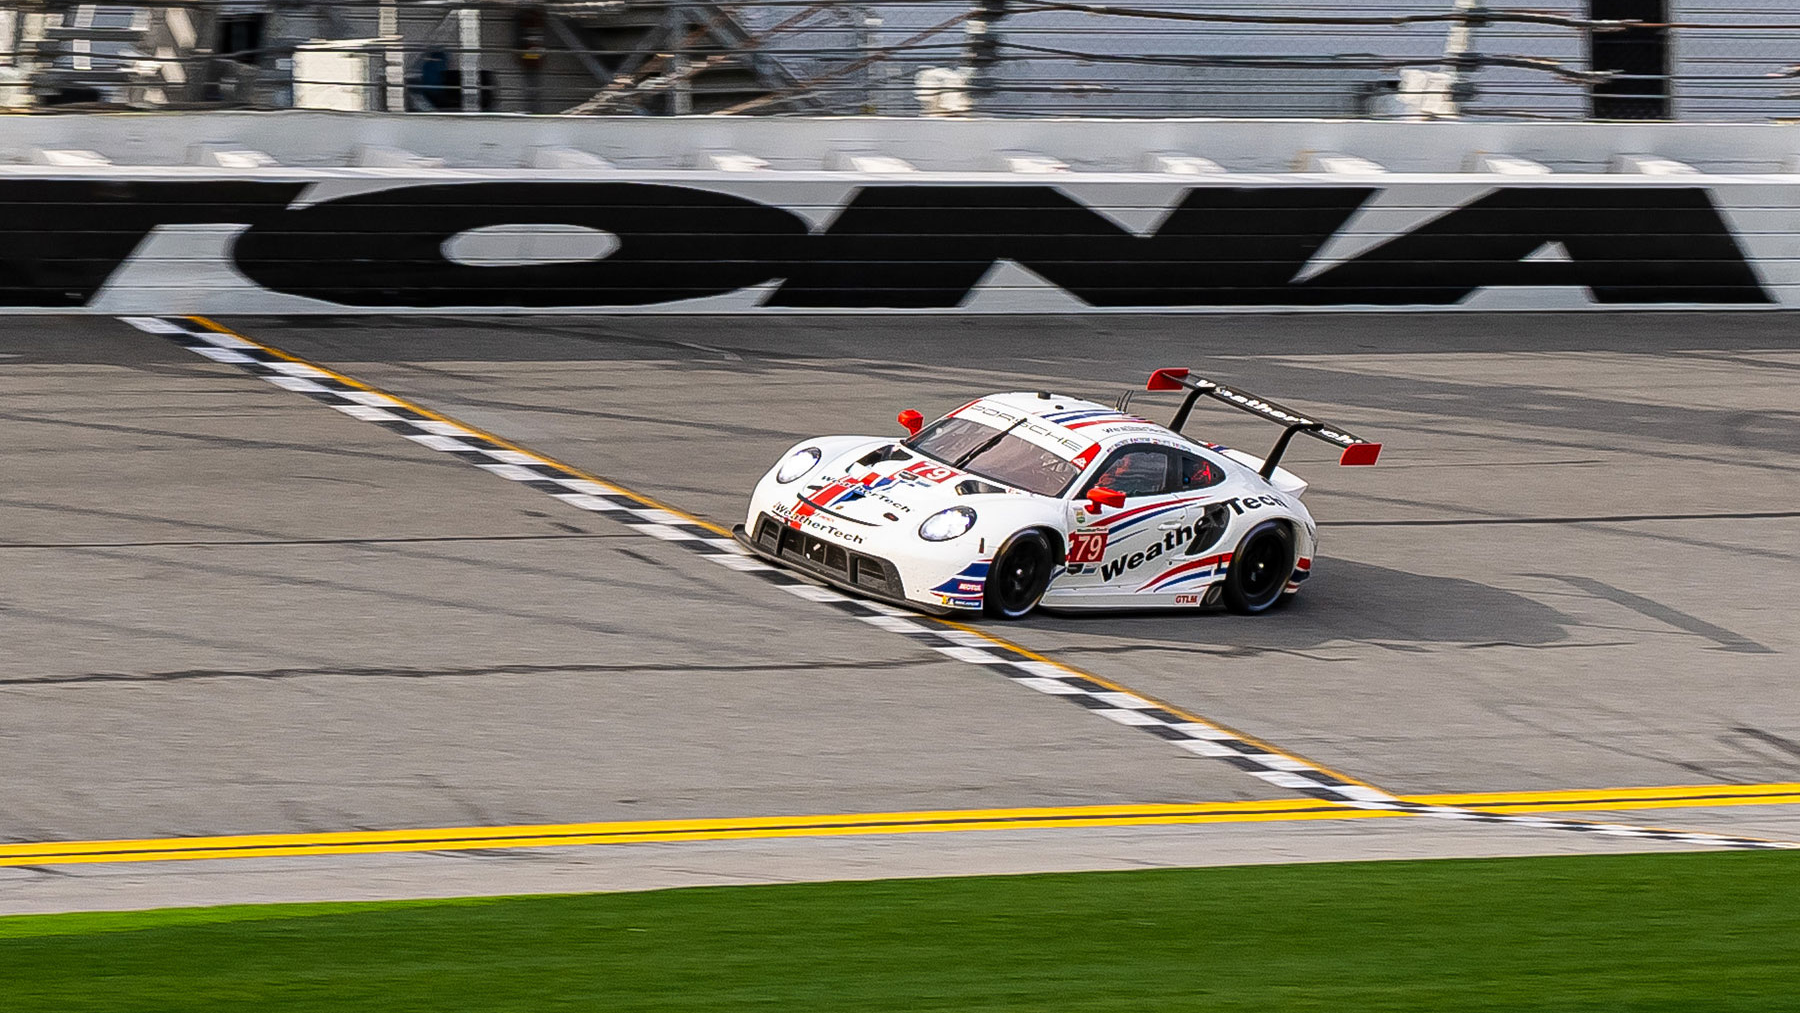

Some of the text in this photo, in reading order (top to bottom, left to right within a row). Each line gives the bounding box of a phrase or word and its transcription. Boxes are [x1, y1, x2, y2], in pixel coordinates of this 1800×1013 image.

[911, 461, 952, 480] 79
[821, 475, 911, 513] WeatherTech
[775, 503, 864, 544] WeatherTech
[1075, 534, 1103, 561] 79
[1175, 595, 1198, 605] GTLM
